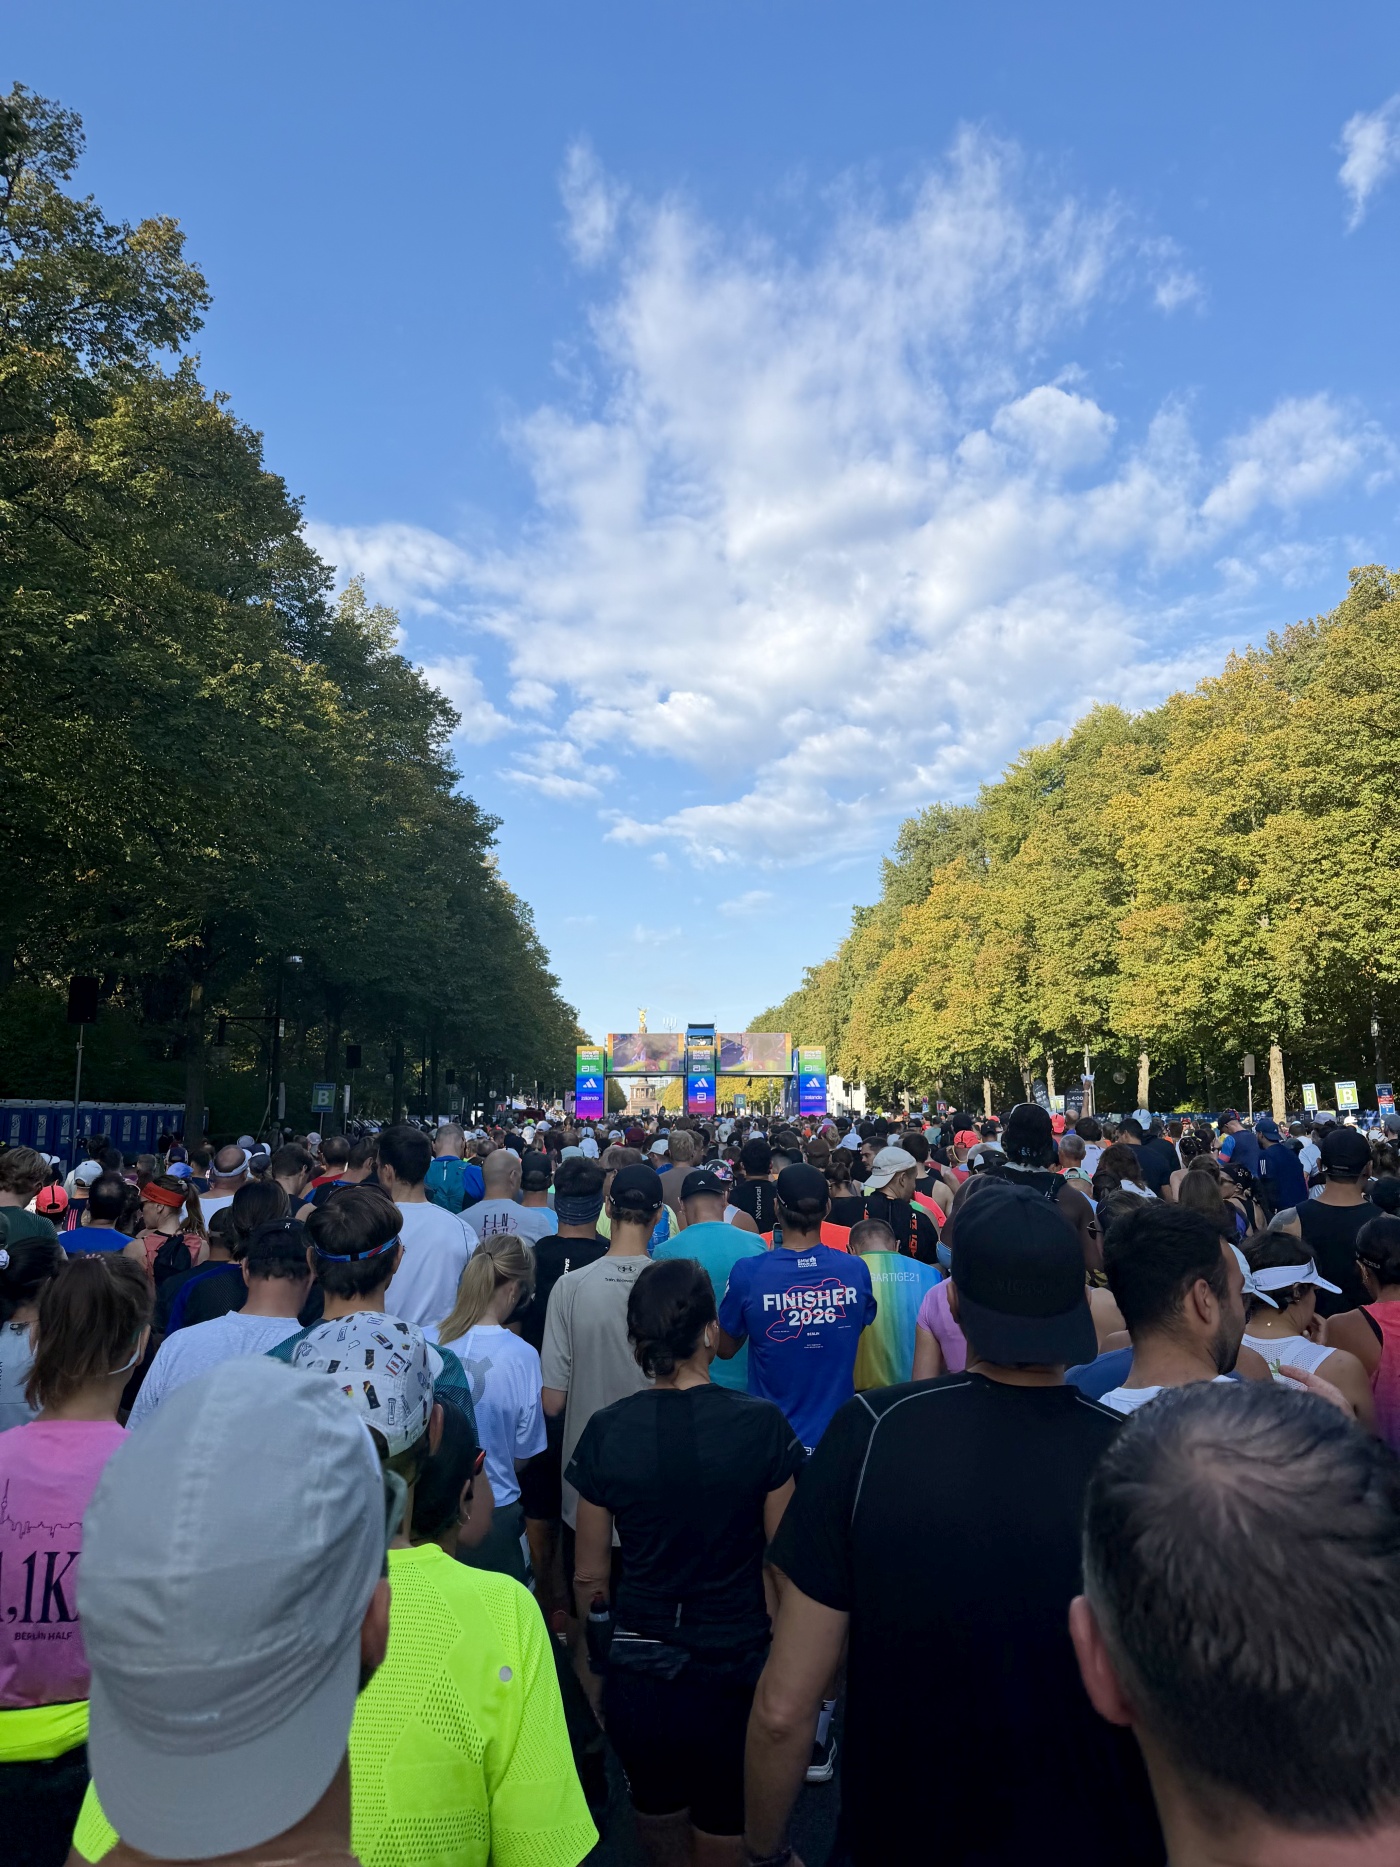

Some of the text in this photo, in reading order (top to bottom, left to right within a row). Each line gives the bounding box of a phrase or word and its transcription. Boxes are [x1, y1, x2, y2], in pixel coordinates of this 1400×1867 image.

[317, 1090, 329, 1106] B
[737, 1096, 744, 1104] B
[1306, 1091, 1313, 1105] B
[1342, 1089, 1354, 1104] B
[451, 1101, 458, 1110] B
[763, 1286, 858, 1312] FINISHER
[788, 1307, 837, 1326] 2026
[15, 1632, 73, 1640] BERLIN HALF
